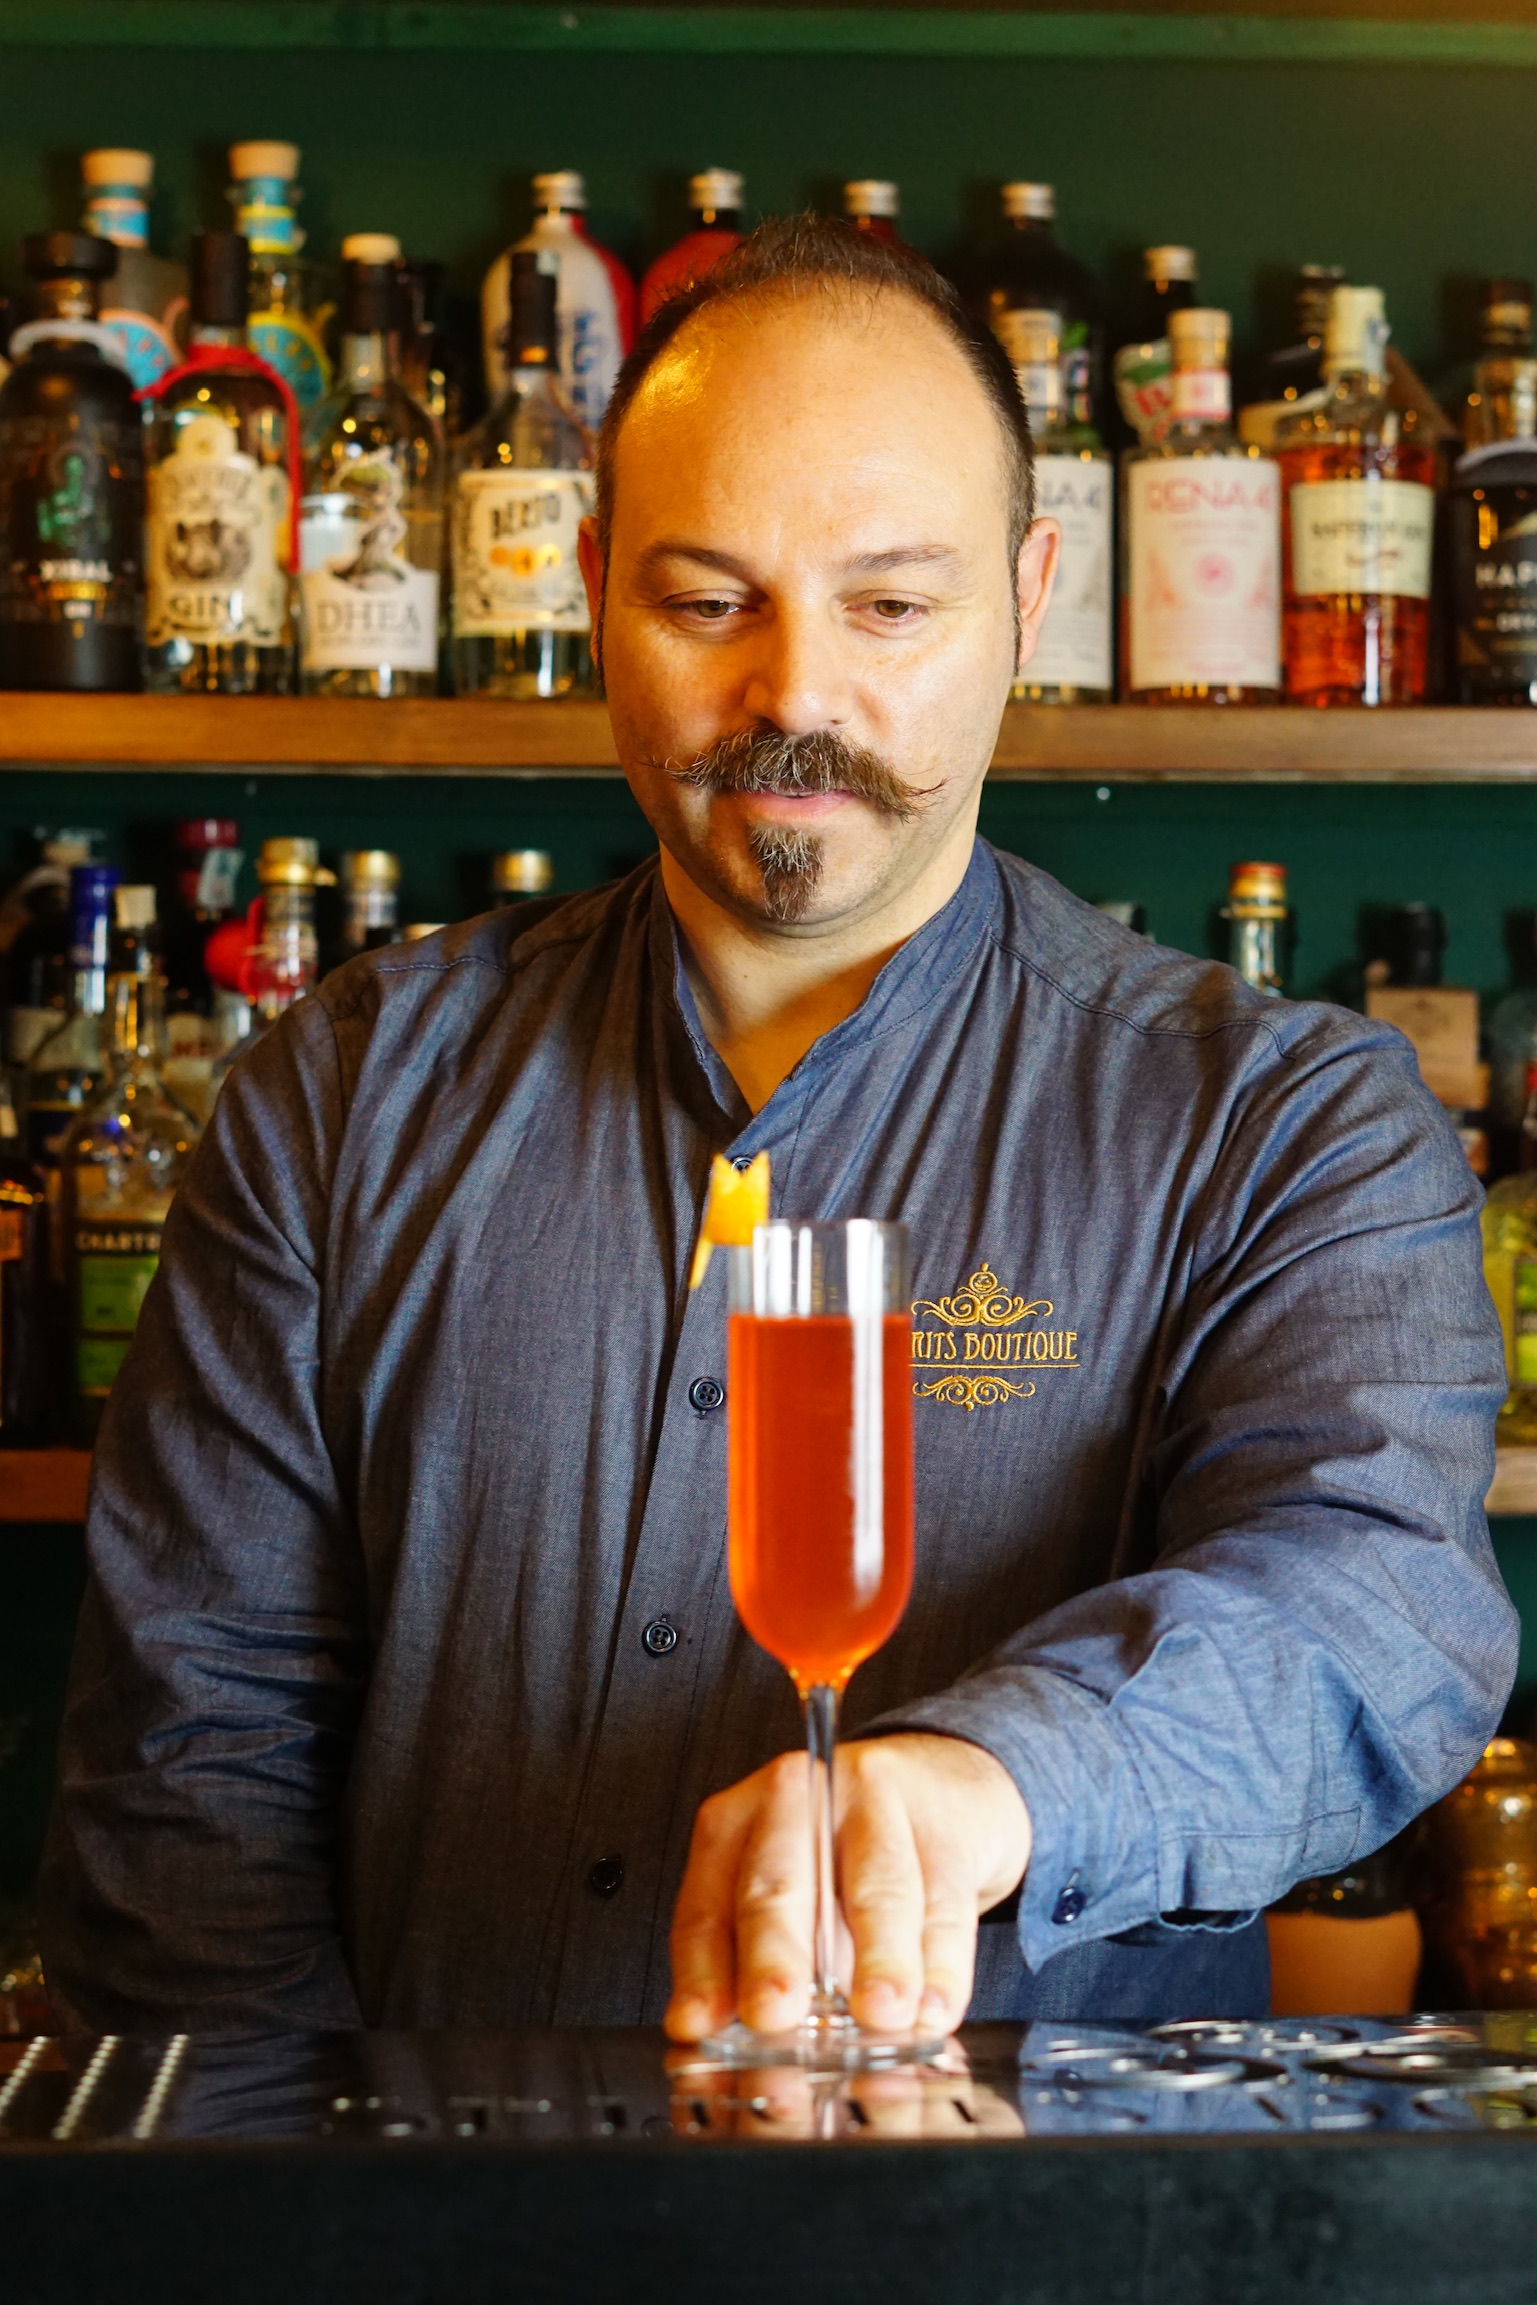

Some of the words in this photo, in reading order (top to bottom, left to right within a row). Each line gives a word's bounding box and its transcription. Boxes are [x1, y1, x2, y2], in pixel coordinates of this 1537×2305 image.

[1475, 561, 1537, 588] HAP
[317, 601, 421, 631] DHEA
[963, 1331, 1078, 1361] BOUTIQUE
